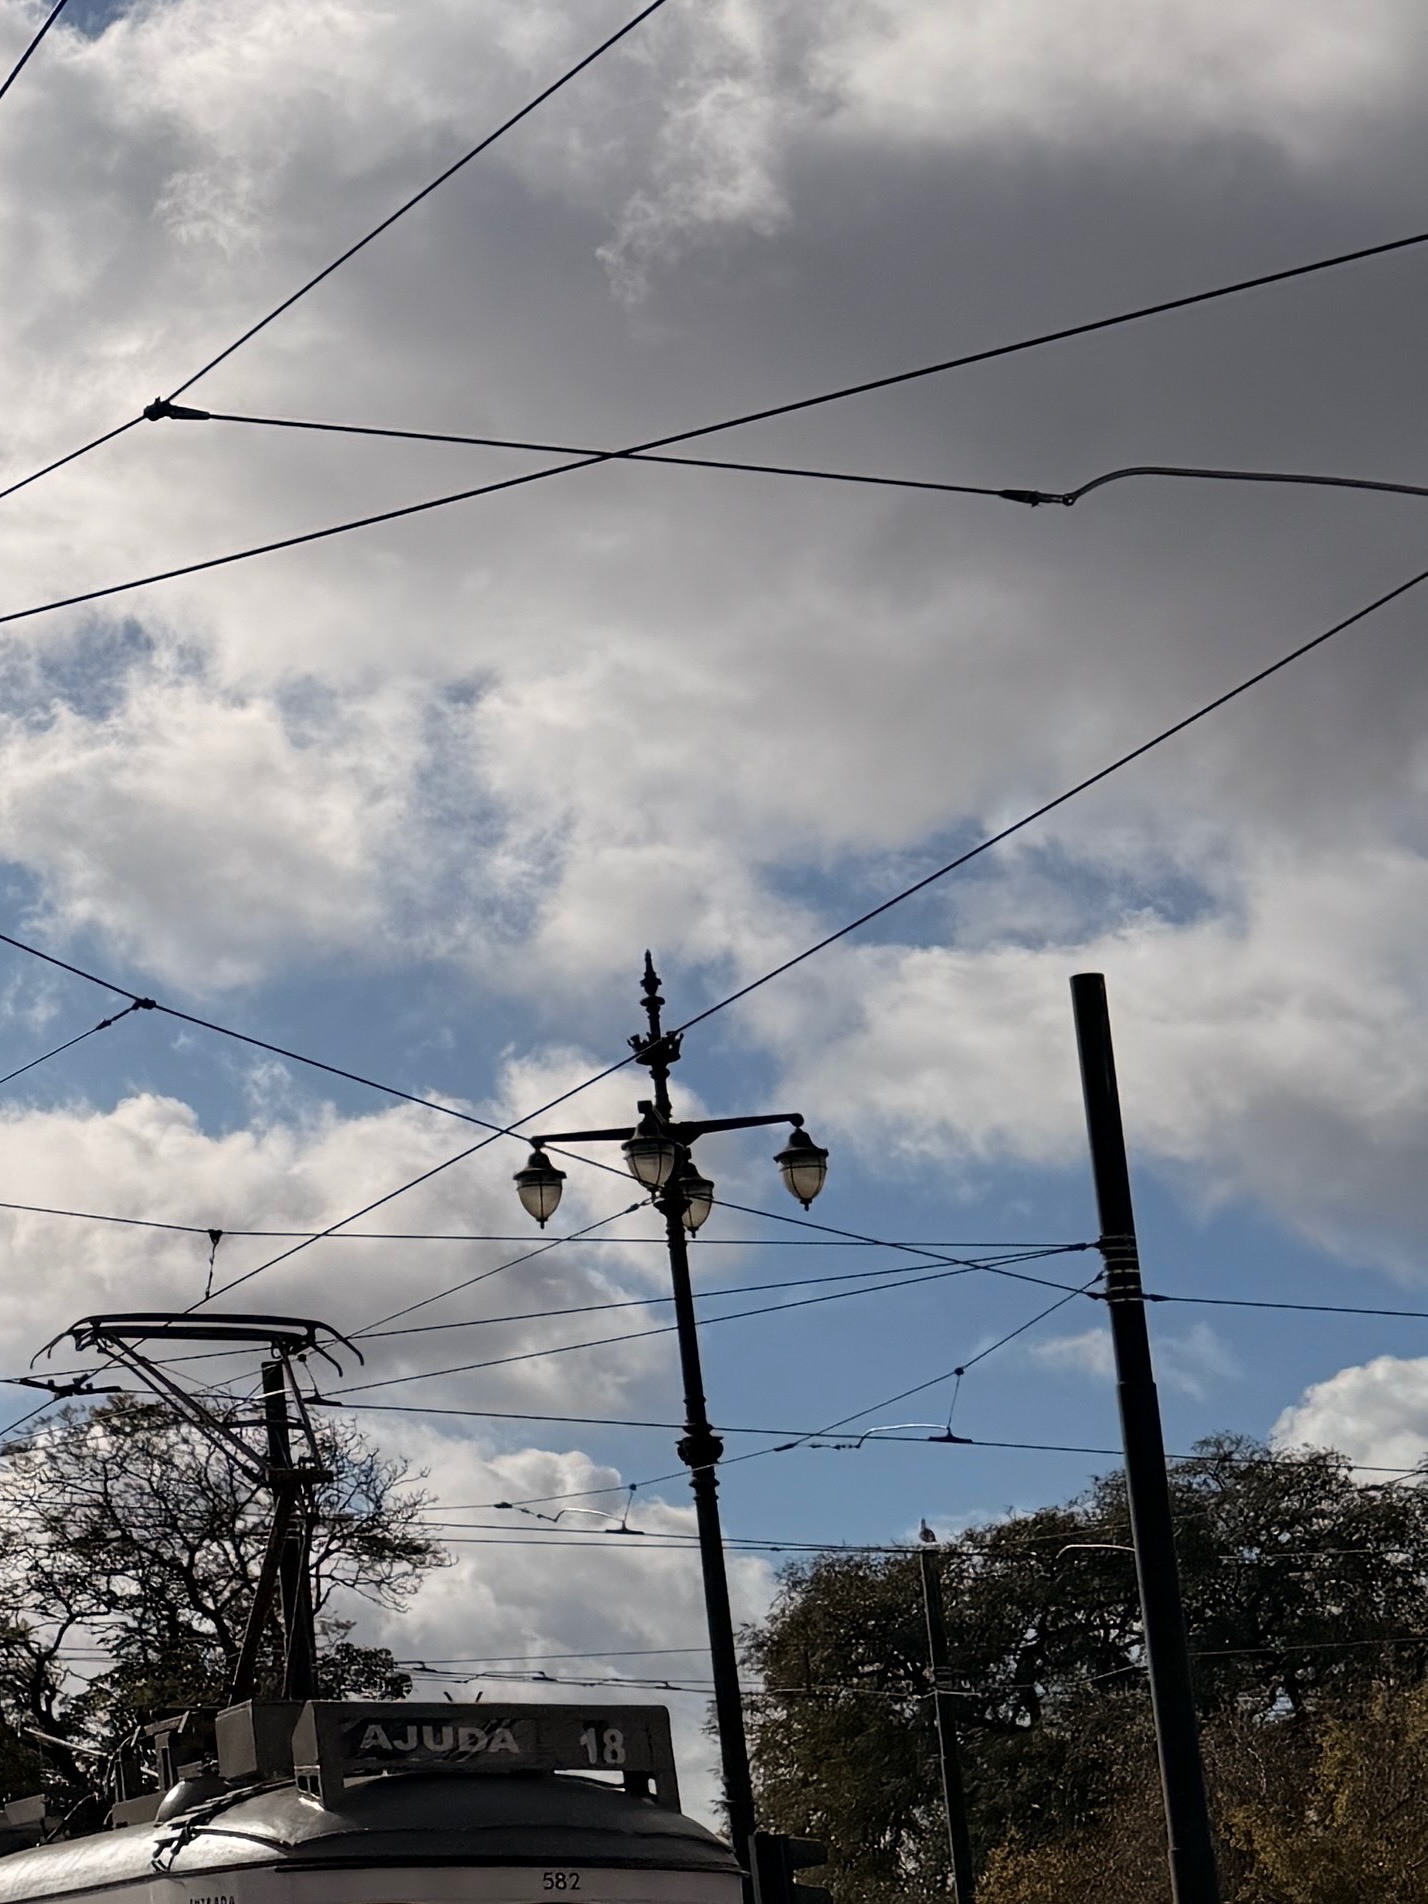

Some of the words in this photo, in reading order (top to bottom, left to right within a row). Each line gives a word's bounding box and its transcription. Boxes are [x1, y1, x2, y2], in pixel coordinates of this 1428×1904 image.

[359, 1724, 522, 1755] AJUDA
[579, 1727, 627, 1765] 18
[542, 1871, 581, 1891] 582
